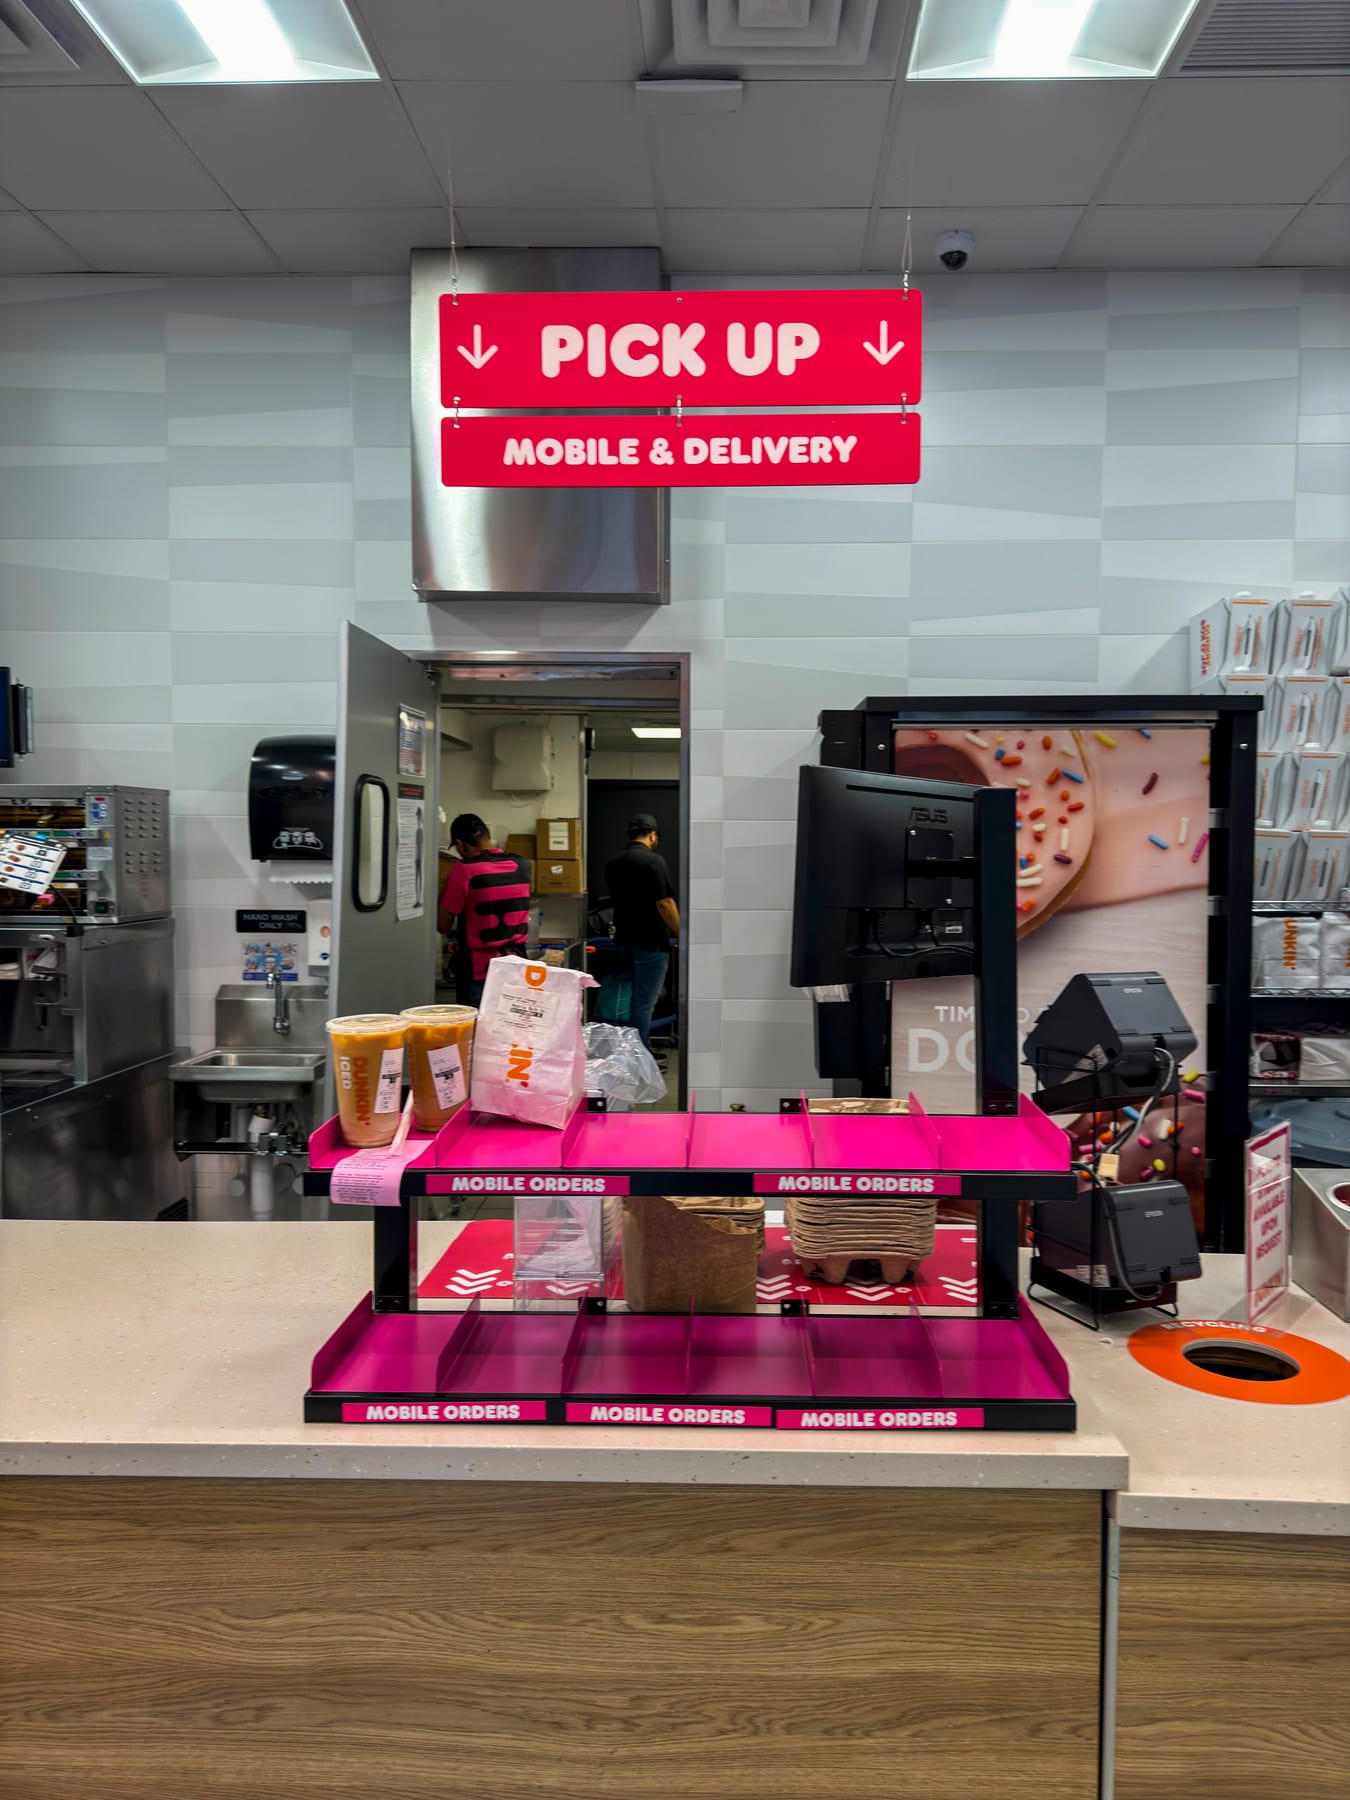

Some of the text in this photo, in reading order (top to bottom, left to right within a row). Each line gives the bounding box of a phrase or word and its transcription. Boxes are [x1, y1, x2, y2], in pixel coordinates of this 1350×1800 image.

[541, 321, 821, 378] PICK UP
[503, 435, 858, 466] MOBILE & DELIVERY
[243, 913, 298, 921] HAND WASH
[934, 1005, 975, 1023] TIM
[339, 1056, 352, 1090] ICED
[452, 1176, 606, 1193] MOBILE ORDERS
[778, 1175, 934, 1193] MOBILE ORDERS
[366, 1404, 521, 1422] MOBILE ORDERS
[590, 1406, 747, 1426] MOBILE ORDERS
[800, 1411, 958, 1429] MOBILE ORDERS
